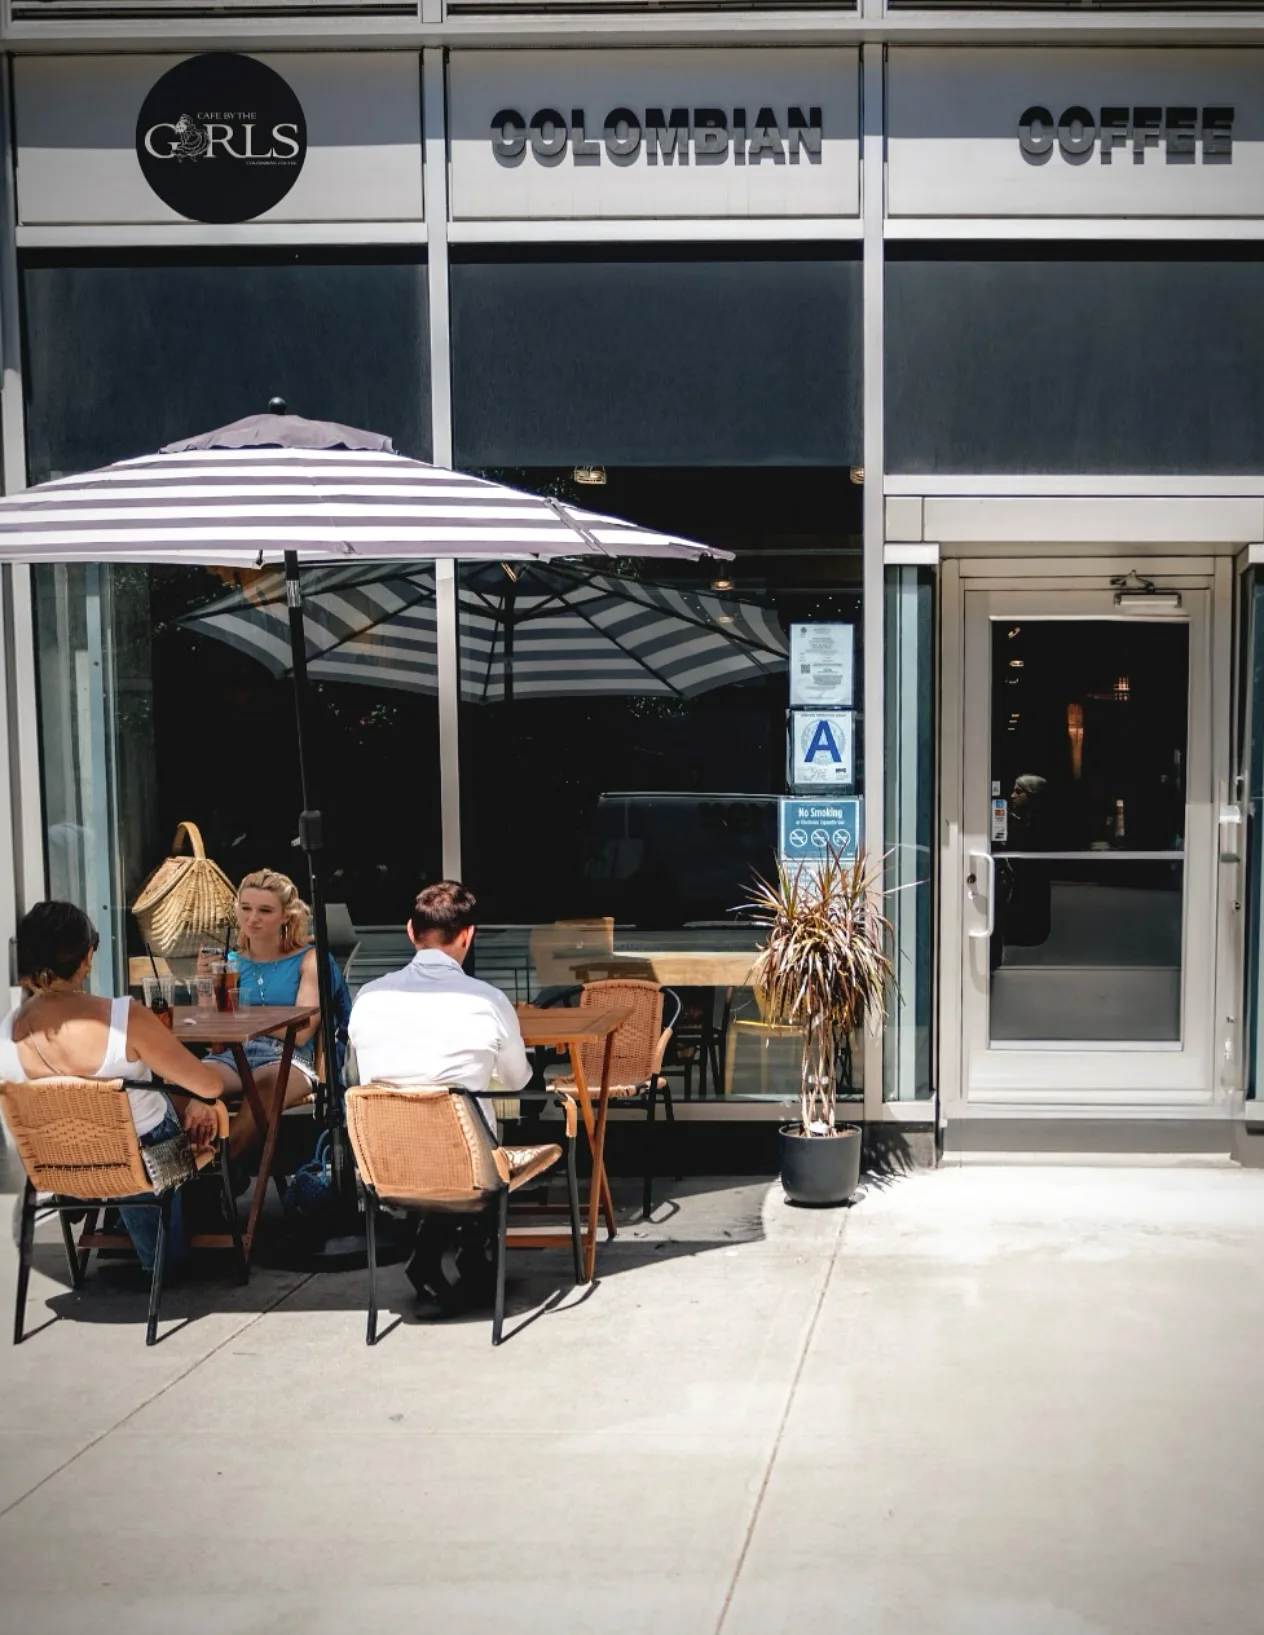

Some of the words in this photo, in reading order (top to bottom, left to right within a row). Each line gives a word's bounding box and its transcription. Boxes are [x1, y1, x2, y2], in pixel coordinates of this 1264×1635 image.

[197, 111, 221, 120] CAFE
[223, 111, 236, 120] BY
[236, 111, 257, 120] THE
[490, 106, 823, 157] COLOMBIAN
[1018, 105, 1235, 156] COFFEE
[144, 122, 300, 160] GRLS
[804, 719, 842, 763] A
[798, 807, 809, 818] No
[810, 807, 843, 819] Smoking
